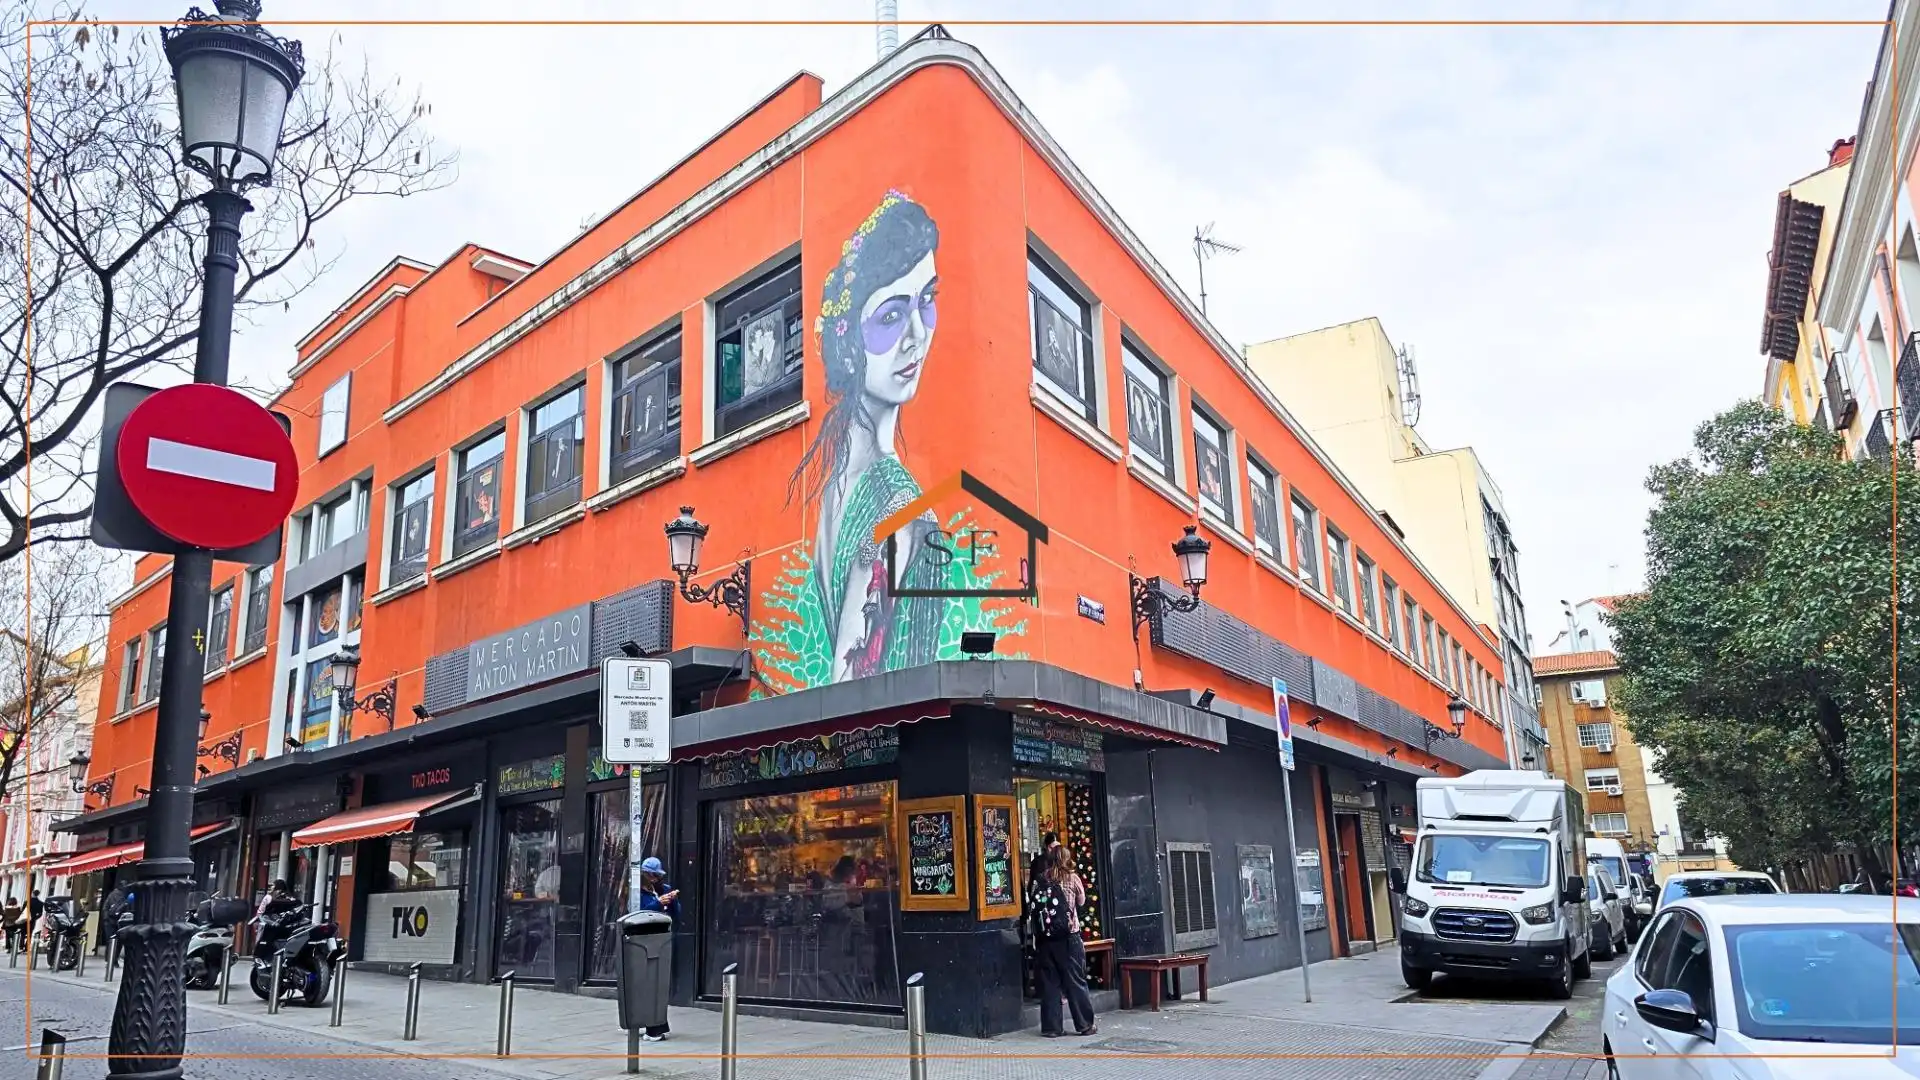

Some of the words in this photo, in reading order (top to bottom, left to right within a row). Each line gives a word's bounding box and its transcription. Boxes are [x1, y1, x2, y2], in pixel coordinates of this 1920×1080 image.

[475, 615, 581, 668] MERCADO
[474, 661, 518, 692] ANTON
[526, 641, 580, 678] MARTIN
[412, 773, 426, 789] TKO
[427, 767, 450, 785] TACOS
[912, 862, 954, 878] MARGARITAS
[924, 878, 933, 891] 5
[392, 905, 429, 939] TKO
